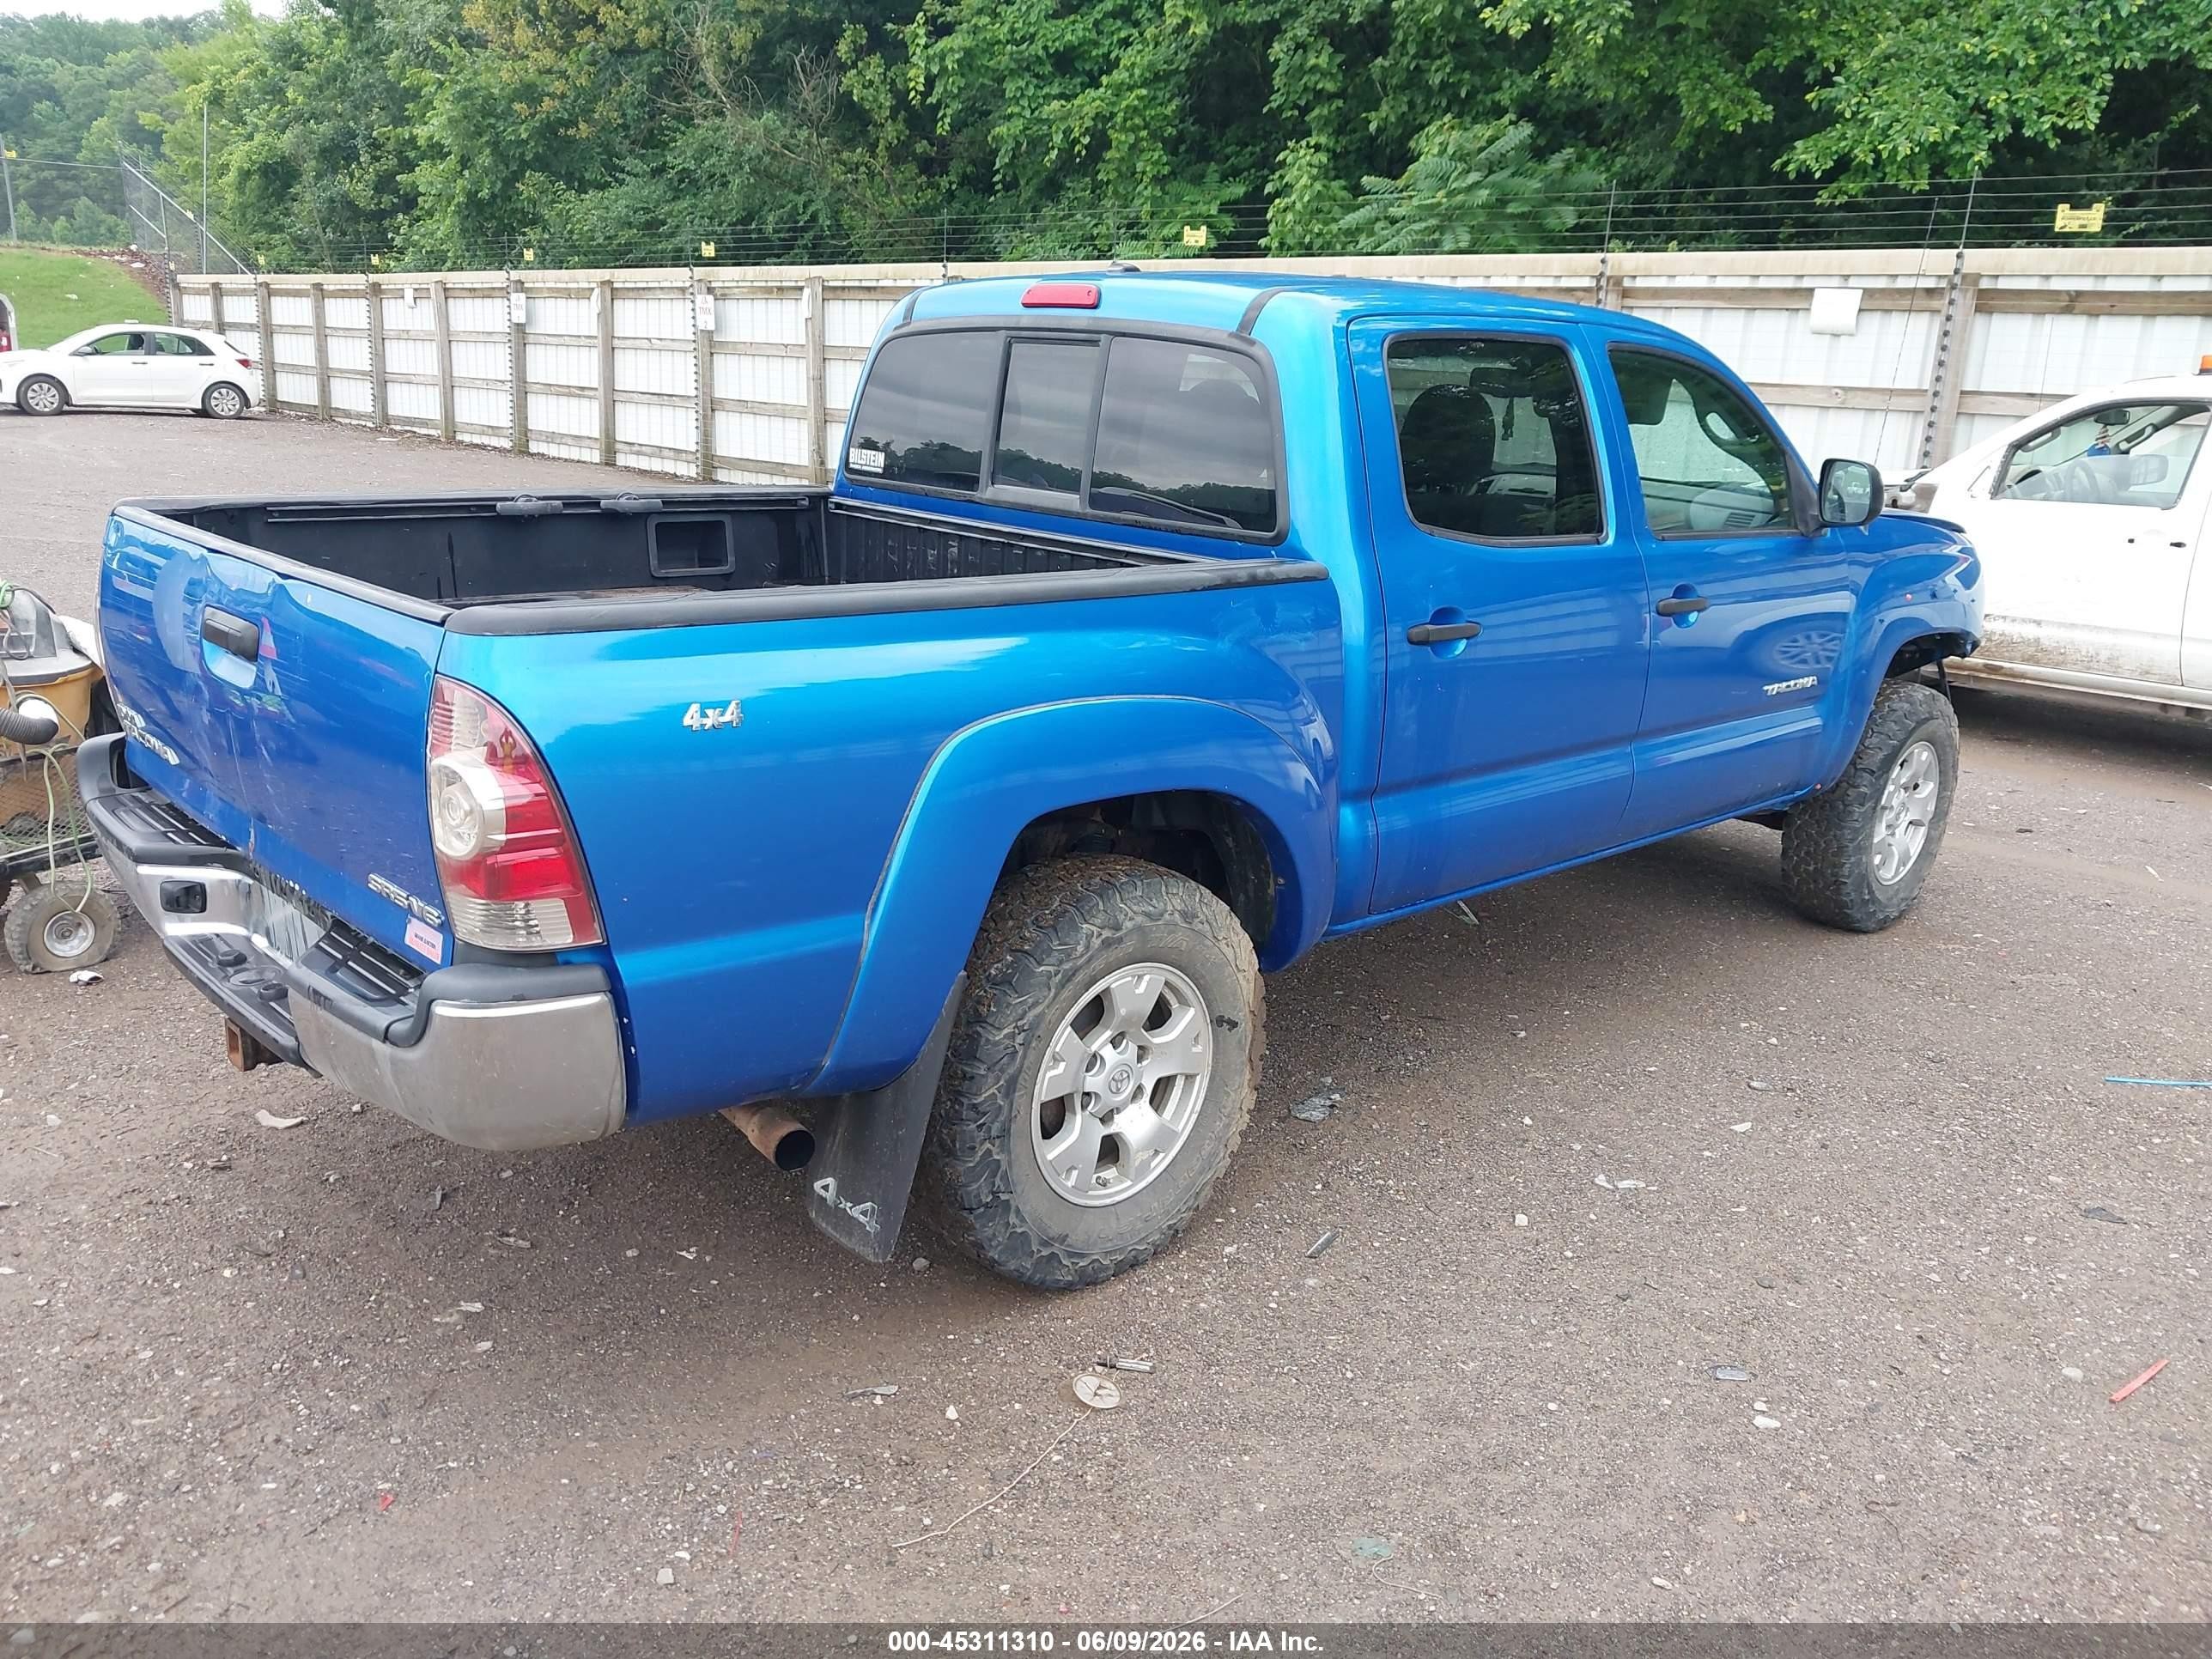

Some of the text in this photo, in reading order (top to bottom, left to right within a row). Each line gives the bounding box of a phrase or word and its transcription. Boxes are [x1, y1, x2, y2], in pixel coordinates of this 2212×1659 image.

[849, 447, 885, 468] BILSTEIN
[1762, 675, 1819, 696] TACOMA
[683, 700, 744, 731] 4x4
[813, 1177, 880, 1235] 4x4
